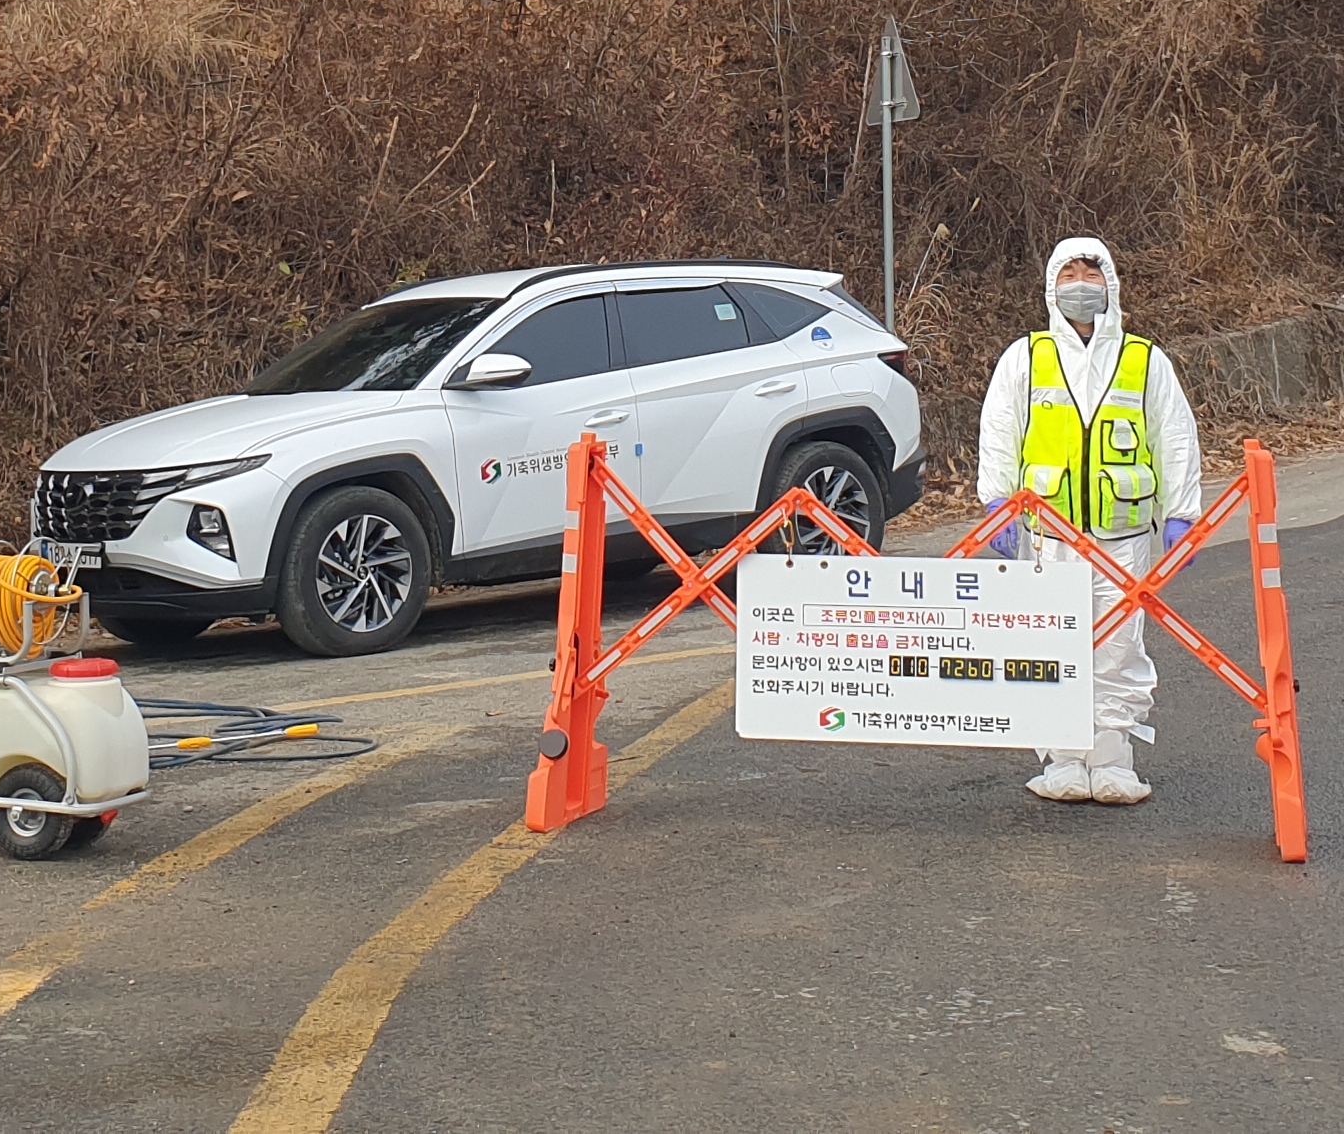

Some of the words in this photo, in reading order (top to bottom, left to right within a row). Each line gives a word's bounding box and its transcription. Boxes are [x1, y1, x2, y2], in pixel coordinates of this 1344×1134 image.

[752, 607, 795, 623] 이곳은
[820, 608, 946, 627] 조류인플루엔자(AI)
[971, 612, 1078, 630] 차단방역조치로
[752, 631, 782, 646] 사람
[796, 631, 839, 648] 차량의
[846, 633, 889, 649] 출입을
[895, 635, 976, 652] 금지합니다.
[752, 655, 822, 672] 문의사항이
[827, 657, 884, 674] 있으시면
[751, 679, 824, 696] 전화주시기
[831, 680, 895, 698] 바랍니다.
[852, 711, 1011, 733] 가축위생방역지원본부
